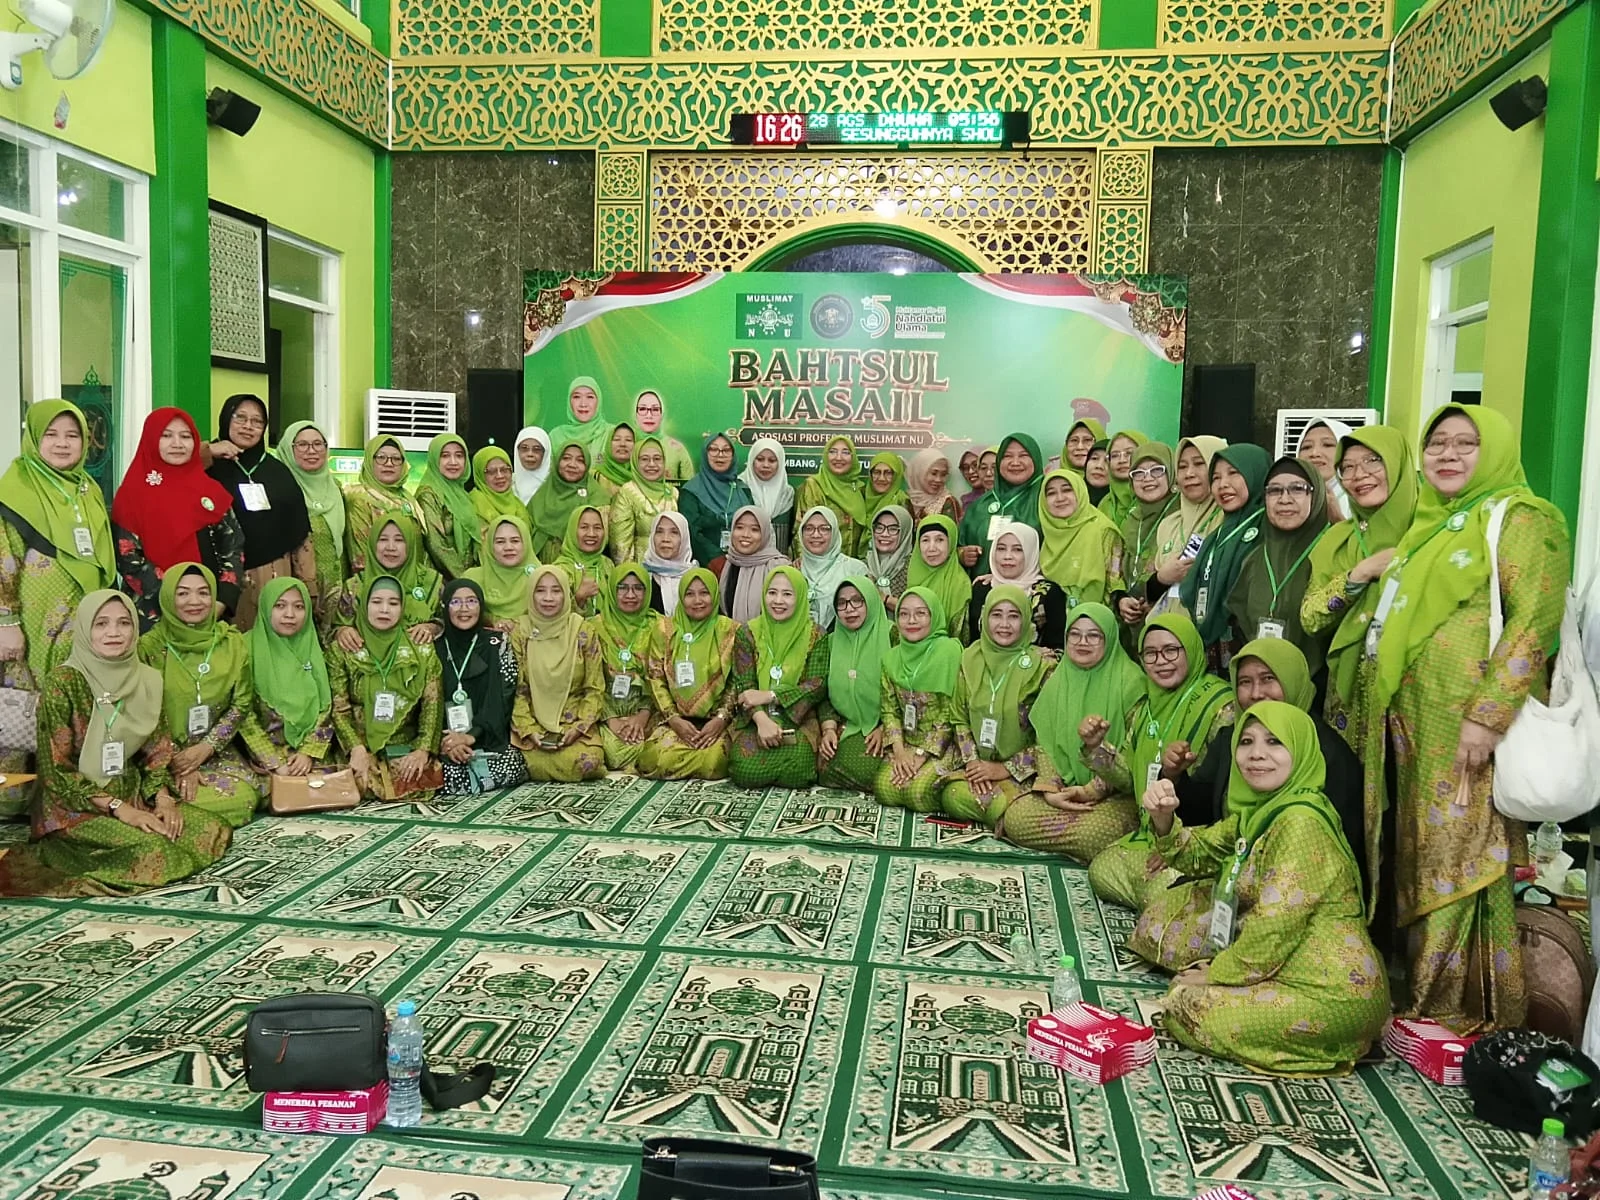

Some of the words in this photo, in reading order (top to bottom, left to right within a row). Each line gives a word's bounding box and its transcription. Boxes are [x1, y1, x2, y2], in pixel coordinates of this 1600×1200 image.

[809, 114, 828, 128] 28
[837, 114, 864, 128] AGS
[961, 127, 1002, 141] SHOL
[746, 294, 793, 303] MUSLIMAT
[895, 314, 946, 323] Nahdlatul
[895, 322, 927, 332] Ulama
[748, 328, 756, 338] N
[784, 328, 791, 338] U
[729, 348, 949, 390] BAHTSUL
[742, 387, 935, 427] MASAIL
[751, 432, 797, 442] ASOSIASI
[854, 434, 907, 444] MUSLIMAT
[909, 435, 924, 445] NU
[273, 1098, 316, 1107] MENERIMA
